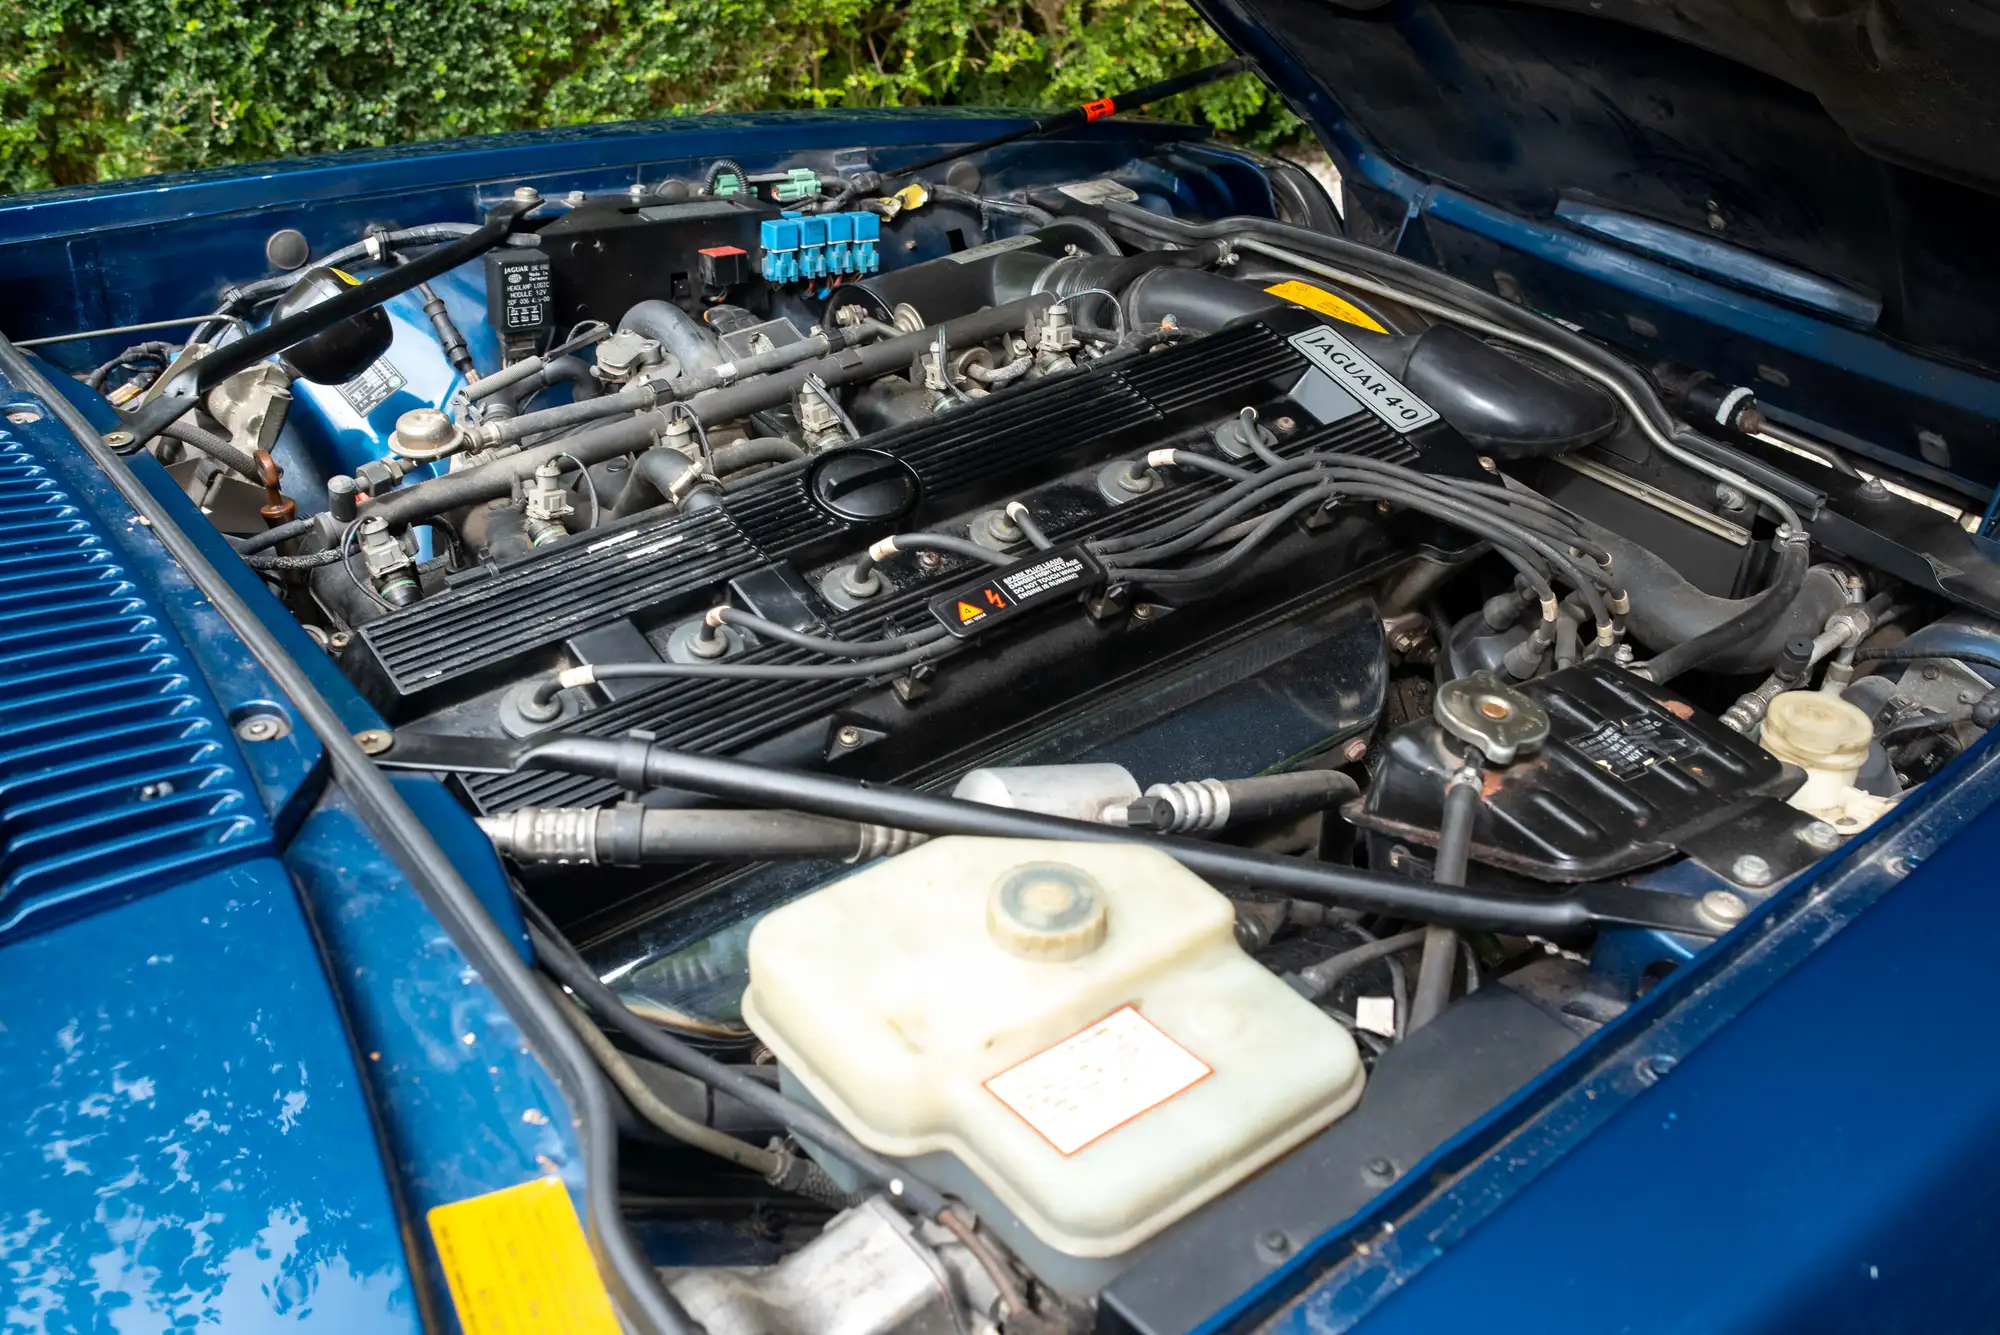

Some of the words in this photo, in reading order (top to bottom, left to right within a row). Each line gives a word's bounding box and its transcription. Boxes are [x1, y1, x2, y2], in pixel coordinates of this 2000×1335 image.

[504, 266, 528, 274] JAGUAR
[1303, 336, 1387, 397] JAGUAR
[1003, 570, 1027, 584] SPARK
[1026, 563, 1044, 577] PLUG
[1041, 556, 1063, 570] LEADS
[1050, 558, 1080, 573] VOLTAGE
[1012, 586, 1024, 595] DO
[1024, 580, 1039, 591] NOT
[1038, 572, 1061, 586] TOUCH
[1059, 564, 1084, 578] WHILST
[1017, 588, 1043, 600] ENGINE
[1049, 573, 1080, 586] RUNNING
